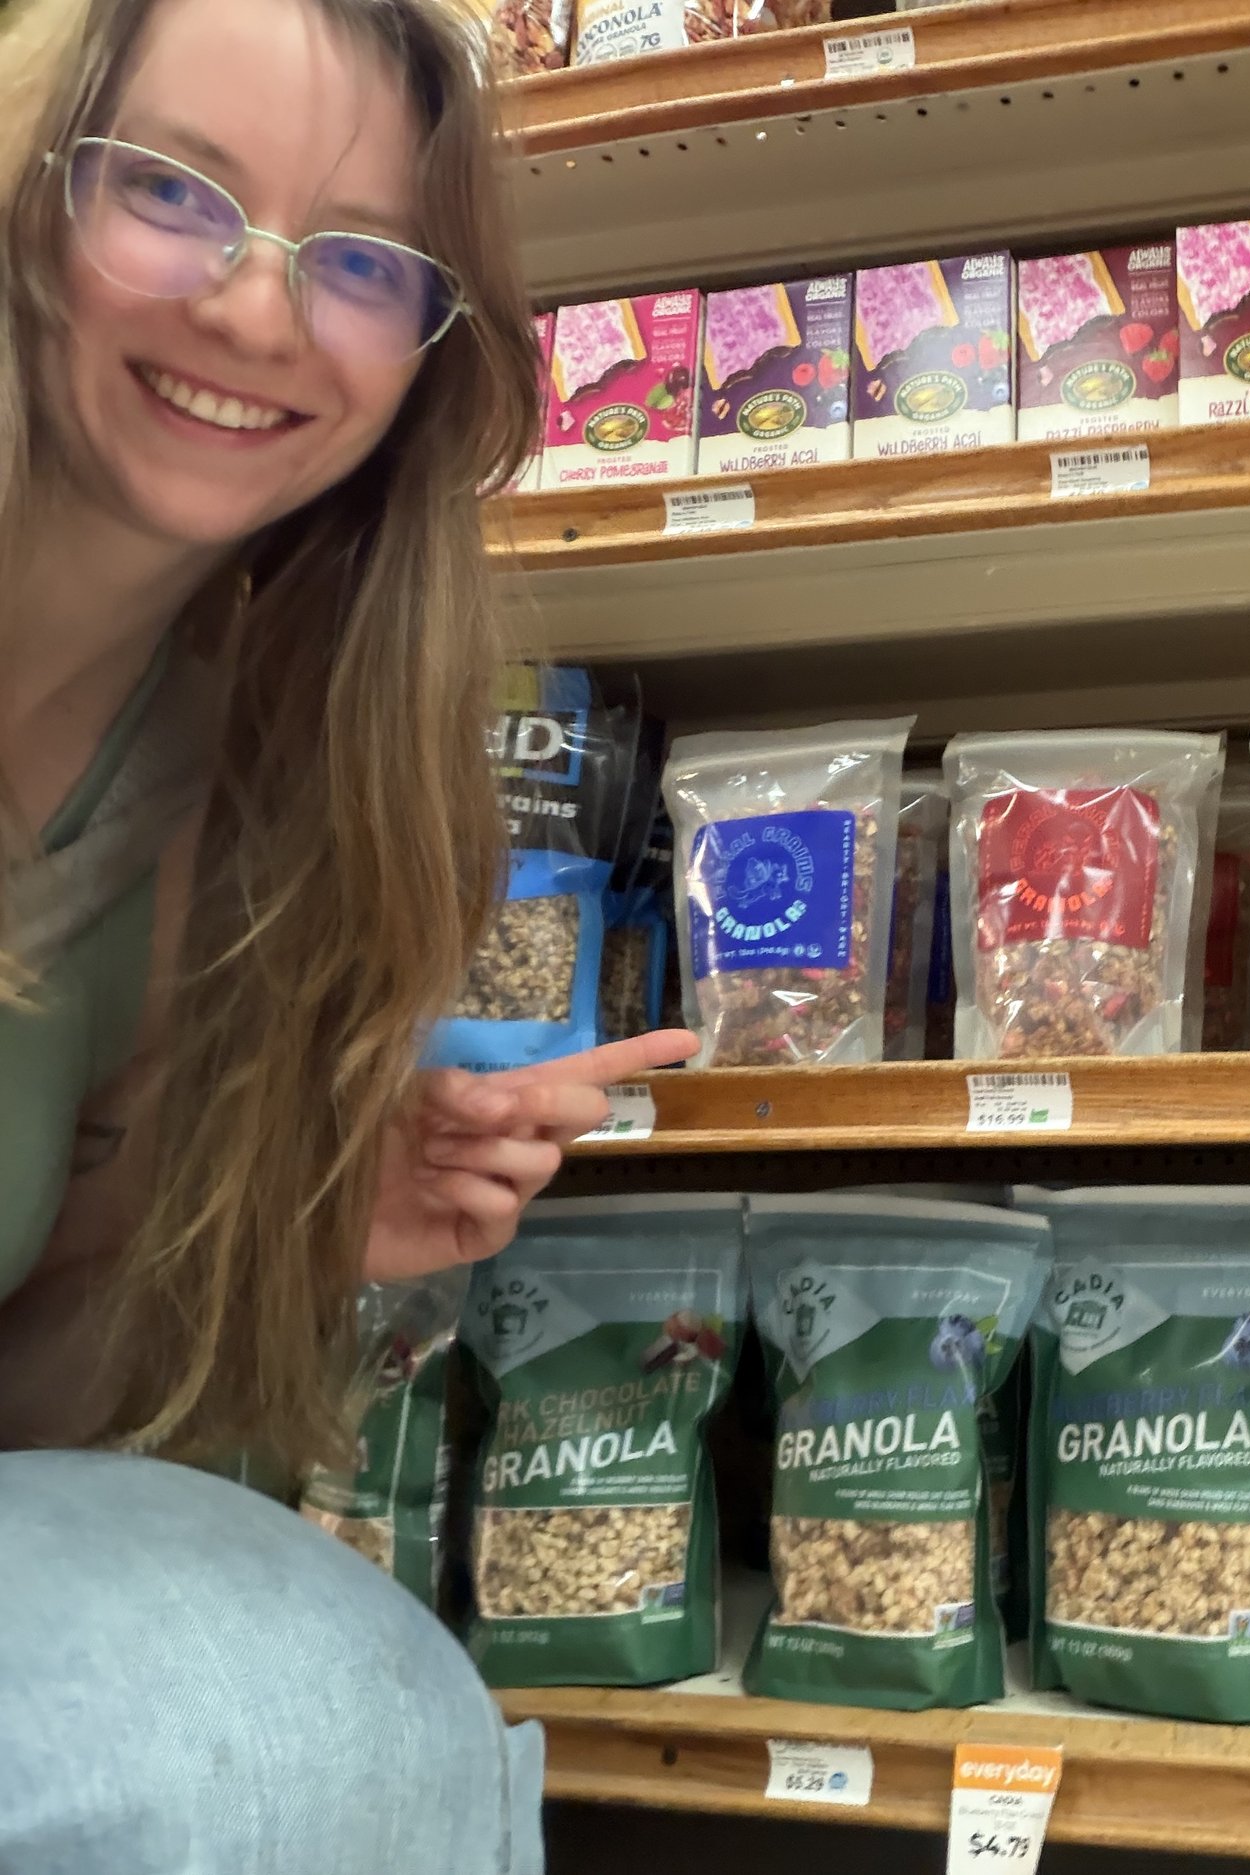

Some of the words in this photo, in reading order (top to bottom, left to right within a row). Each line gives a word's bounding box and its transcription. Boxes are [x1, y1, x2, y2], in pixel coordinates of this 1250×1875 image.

[900, 374, 941, 397] NATURE'S
[941, 374, 961, 392] PATH
[1066, 363, 1108, 385] NATURE'S
[1108, 363, 1130, 381] PATH
[742, 394, 782, 415] NATURE'S
[782, 394, 801, 411] PATH
[753, 427, 789, 438] ORGANIC
[911, 426, 950, 436] FROSTED
[753, 444, 788, 453] FROSTED
[1055, 1274, 1125, 1311] CADIA
[540, 1371, 701, 1417] CHOCOLATE
[501, 1400, 653, 1447] HAZELNUT
[776, 1410, 962, 1472] GRANOLA
[481, 1419, 679, 1494] GRANOLA
[808, 1457, 885, 1483] NATURALLY
[886, 1451, 962, 1472] FLAVORED
[1098, 1455, 1177, 1479] NATURALLY
[958, 1760, 1056, 1788] everyday
[967, 1831, 1032, 1859] $4.79
